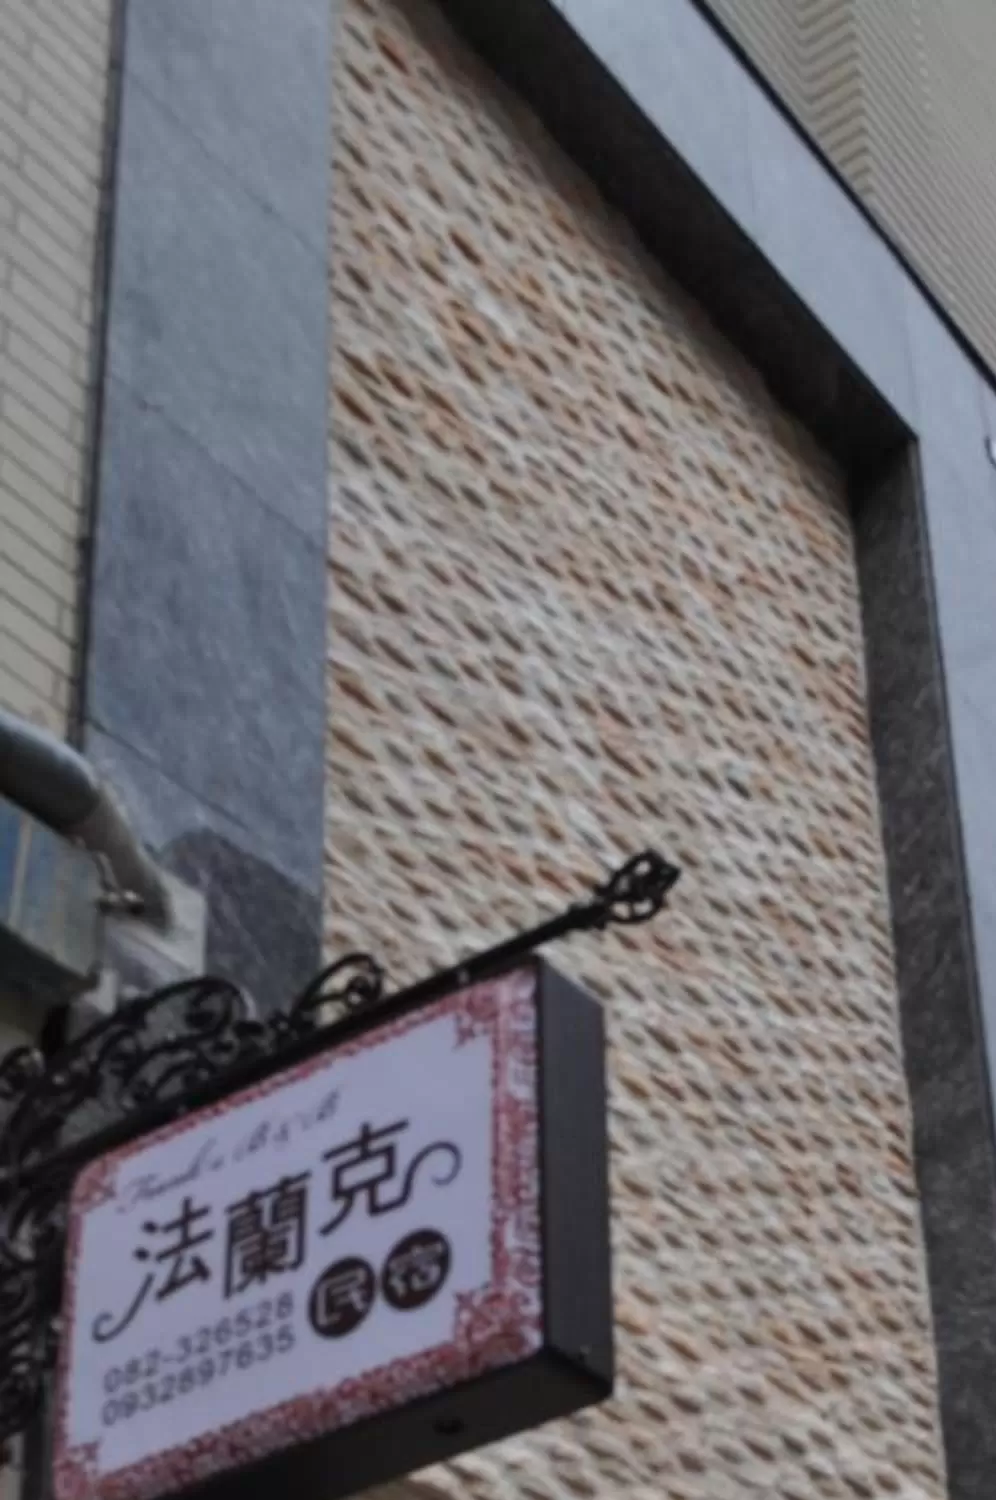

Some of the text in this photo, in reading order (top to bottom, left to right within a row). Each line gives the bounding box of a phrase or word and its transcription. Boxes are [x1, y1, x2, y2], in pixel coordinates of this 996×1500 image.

[92, 1119, 461, 1342] 法蘭克
[314, 1240, 444, 1328] 民宿
[101, 1322, 296, 1426] 0932897635
[103, 1291, 294, 1393] 082-326528
